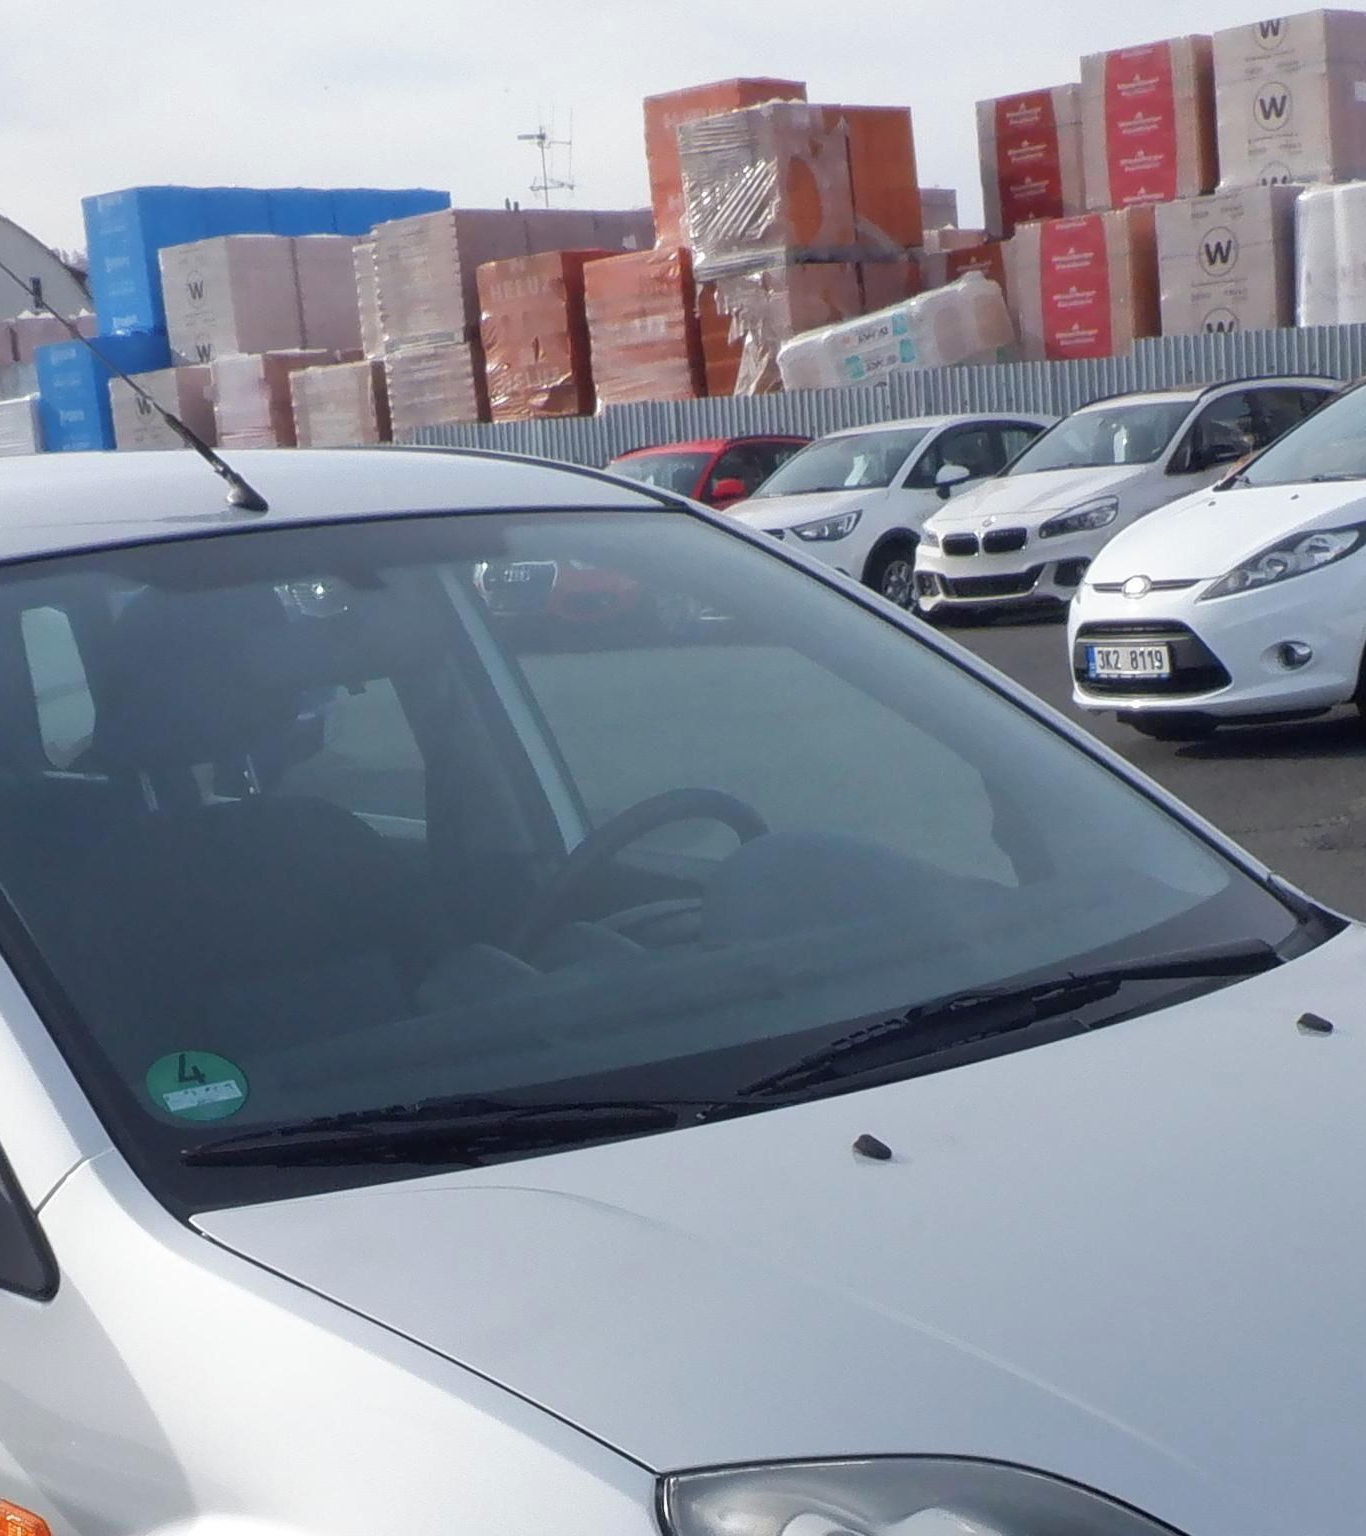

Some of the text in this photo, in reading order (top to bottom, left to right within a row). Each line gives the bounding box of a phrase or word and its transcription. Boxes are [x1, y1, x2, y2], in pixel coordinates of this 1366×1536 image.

[1258, 18, 1281, 40] W
[1259, 94, 1287, 121] W
[1204, 240, 1232, 266] W
[188, 280, 204, 300] W
[195, 344, 213, 365] W
[1097, 649, 1122, 671] 3K2
[1129, 649, 1164, 671] 8119
[178, 1053, 205, 1086] 4
